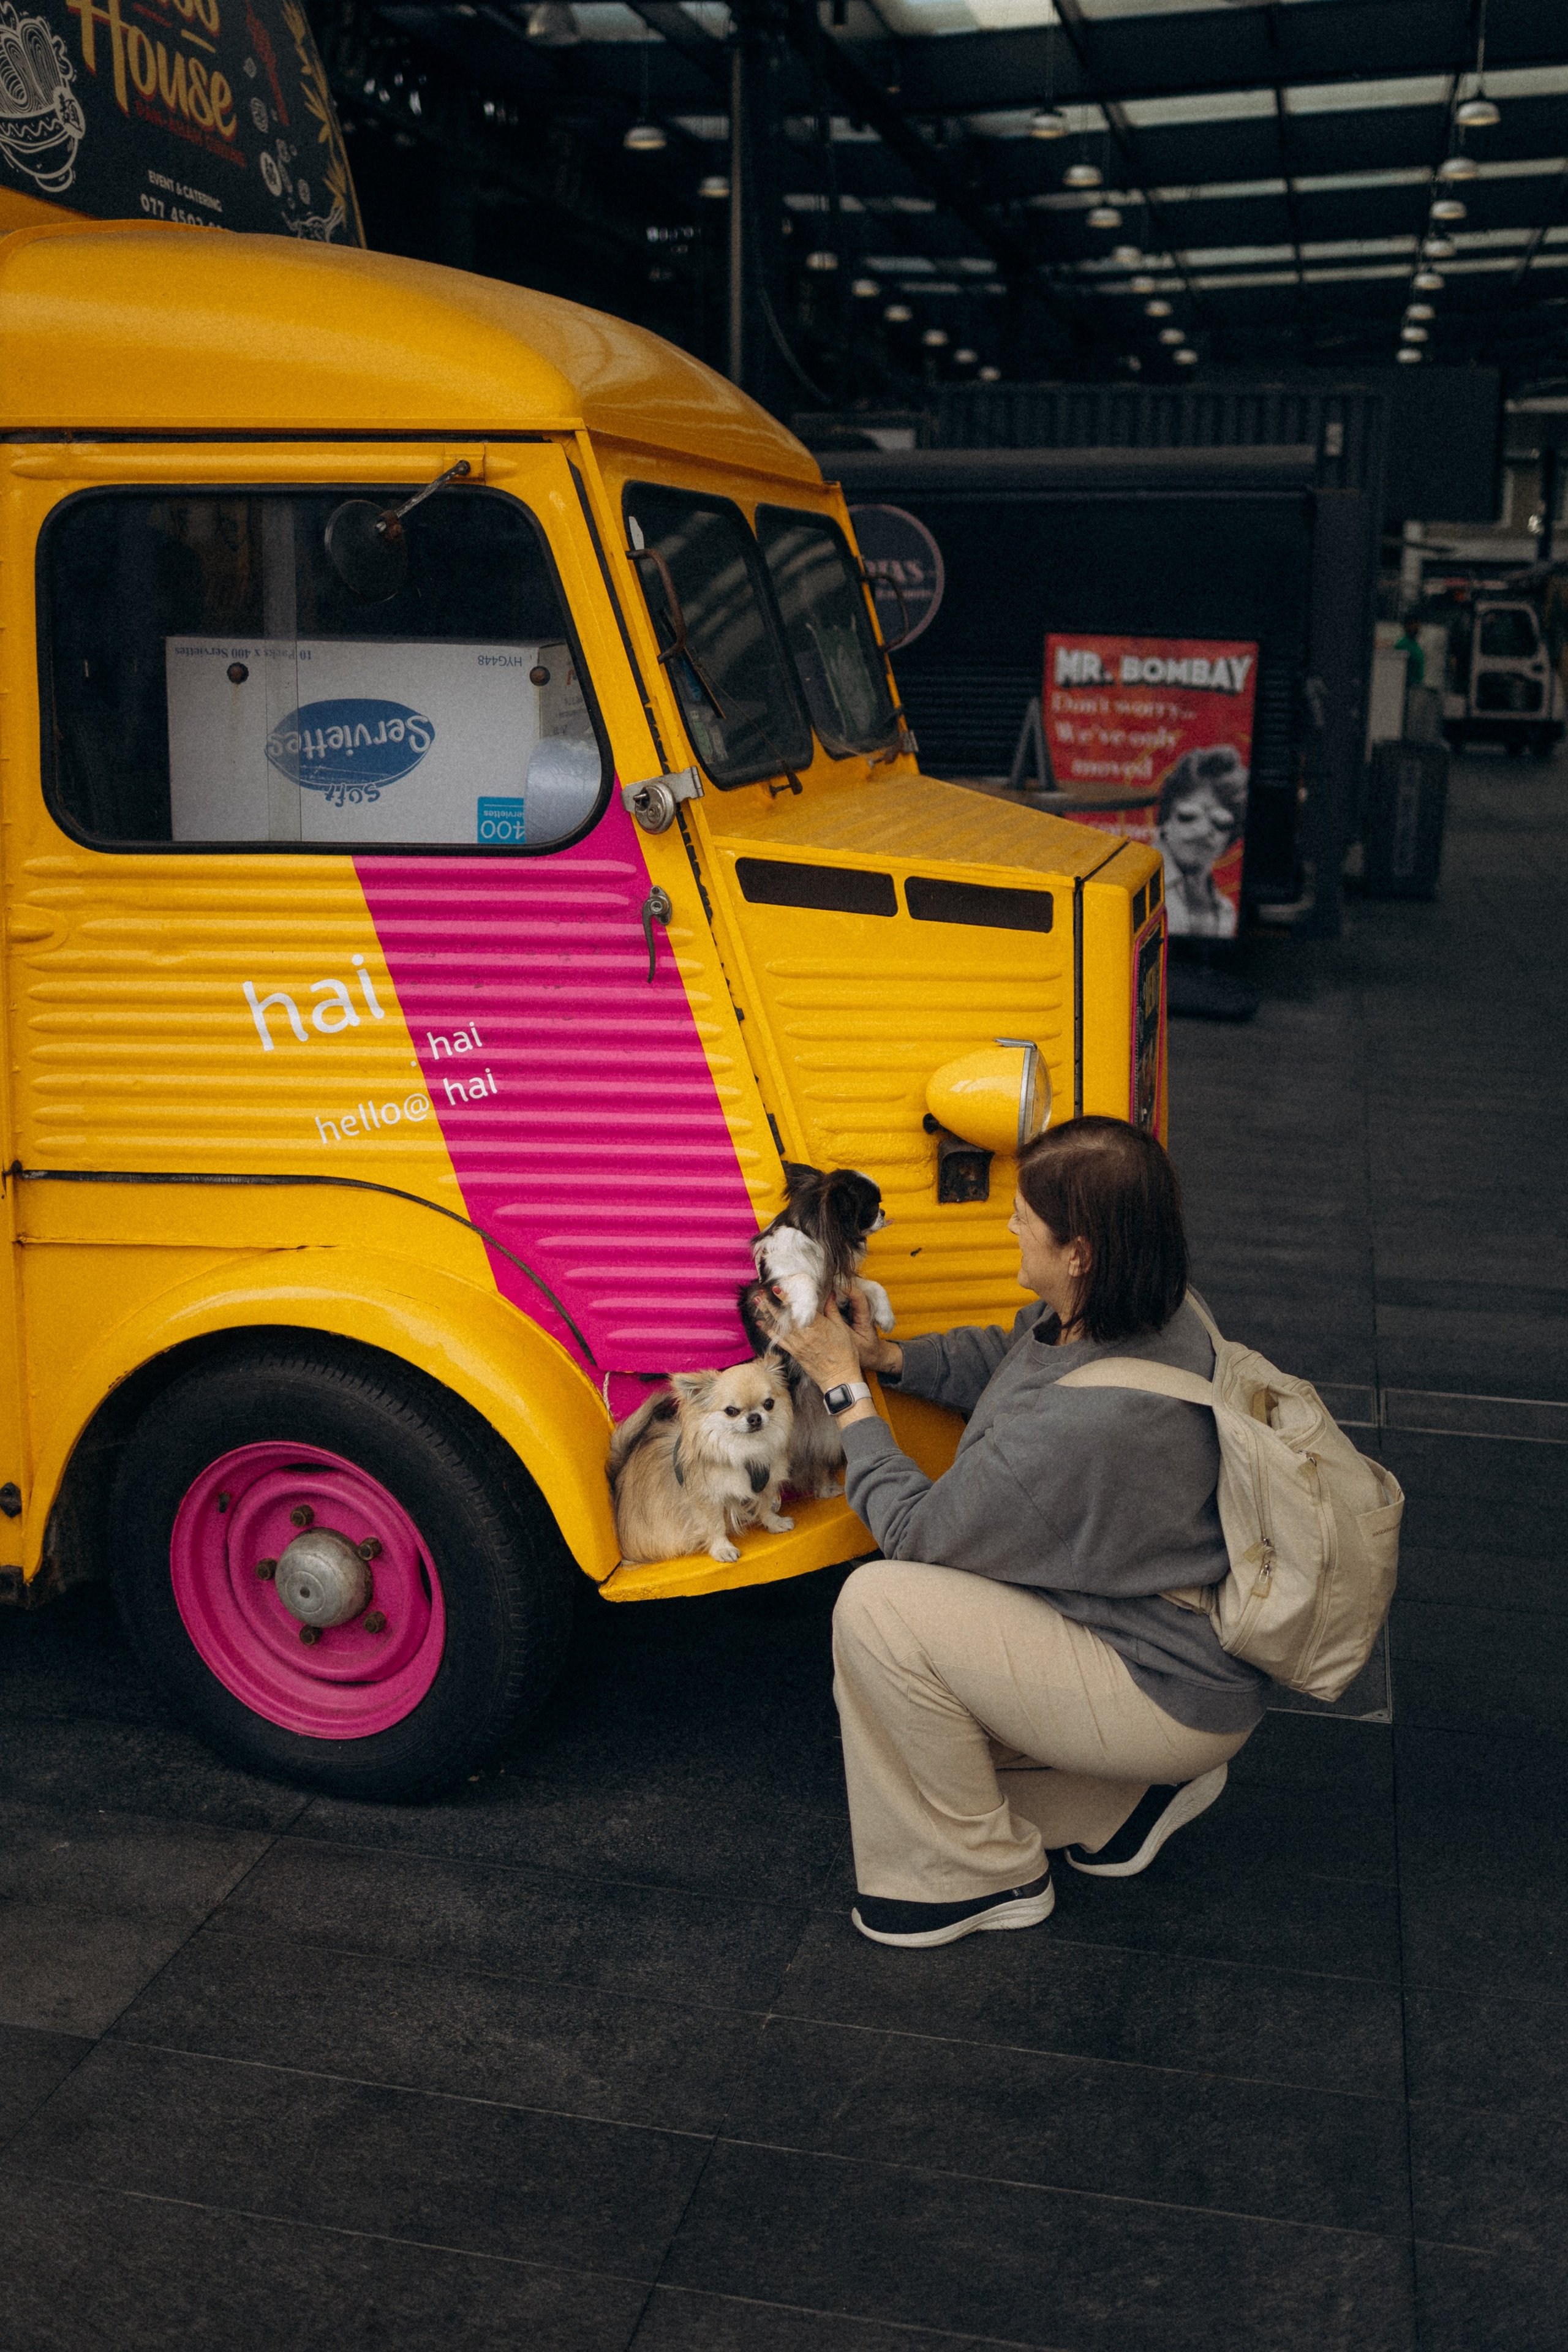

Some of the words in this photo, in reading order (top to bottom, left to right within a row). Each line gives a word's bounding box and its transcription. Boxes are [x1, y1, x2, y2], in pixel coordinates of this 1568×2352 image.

[66, 0, 238, 141] House
[148, 169, 175, 192] EVENT
[176, 182, 183, 196] &
[183, 186, 223, 212] CATERING
[140, 193, 165, 219] 077
[175, 647, 228, 658] Serviettes
[232, 649, 251, 658] 400
[264, 649, 295, 659] Packs
[300, 650, 312, 660] 10
[478, 655, 522, 666] HYG448
[1055, 646, 1114, 687] MR.
[1121, 655, 1253, 693] BOMBAY
[267, 715, 430, 760] Serviettes
[484, 810, 524, 819] erviettes
[480, 820, 525, 840] 400
[243, 954, 385, 1051] hai
[427, 1022, 482, 1060] hai
[315, 1093, 429, 1144] hello@
[443, 1068, 497, 1105] hai
